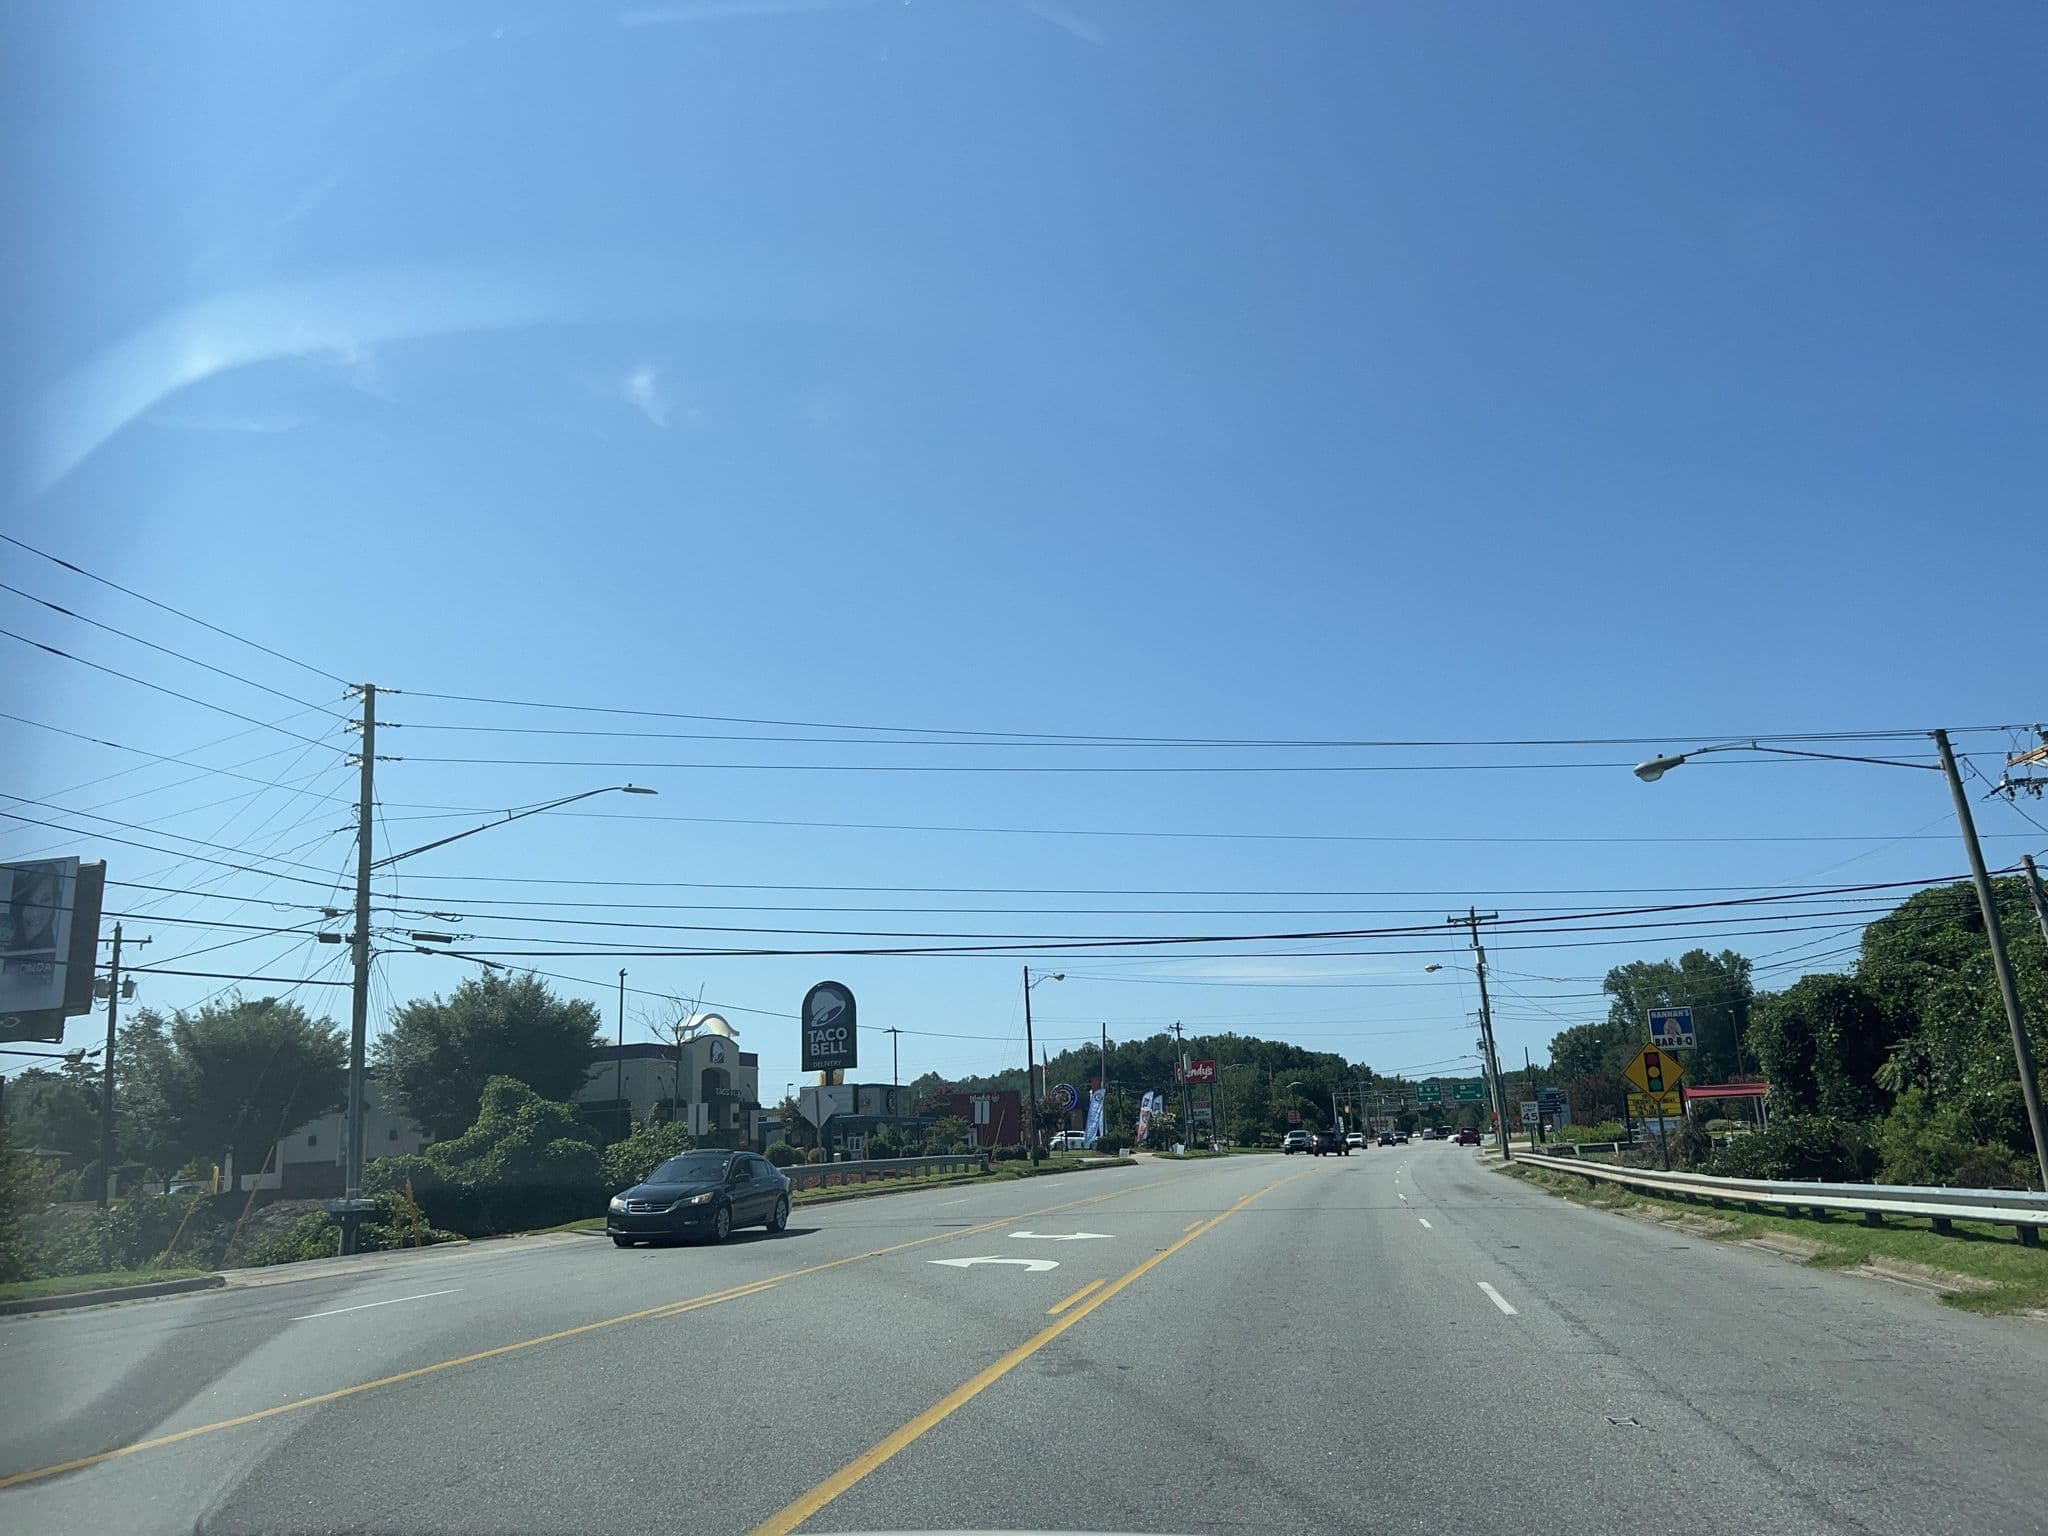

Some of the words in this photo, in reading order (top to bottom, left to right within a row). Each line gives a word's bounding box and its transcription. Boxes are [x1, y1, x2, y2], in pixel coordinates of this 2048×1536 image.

[1650, 1009, 1690, 1019] HANNAH'S
[808, 1027, 848, 1043] TACO
[1655, 1036, 1693, 1047] BAR-B-Q
[810, 1042, 848, 1056] BELL
[812, 1059, 842, 1068] DELIVERY
[1523, 1112, 1538, 1121] 45
